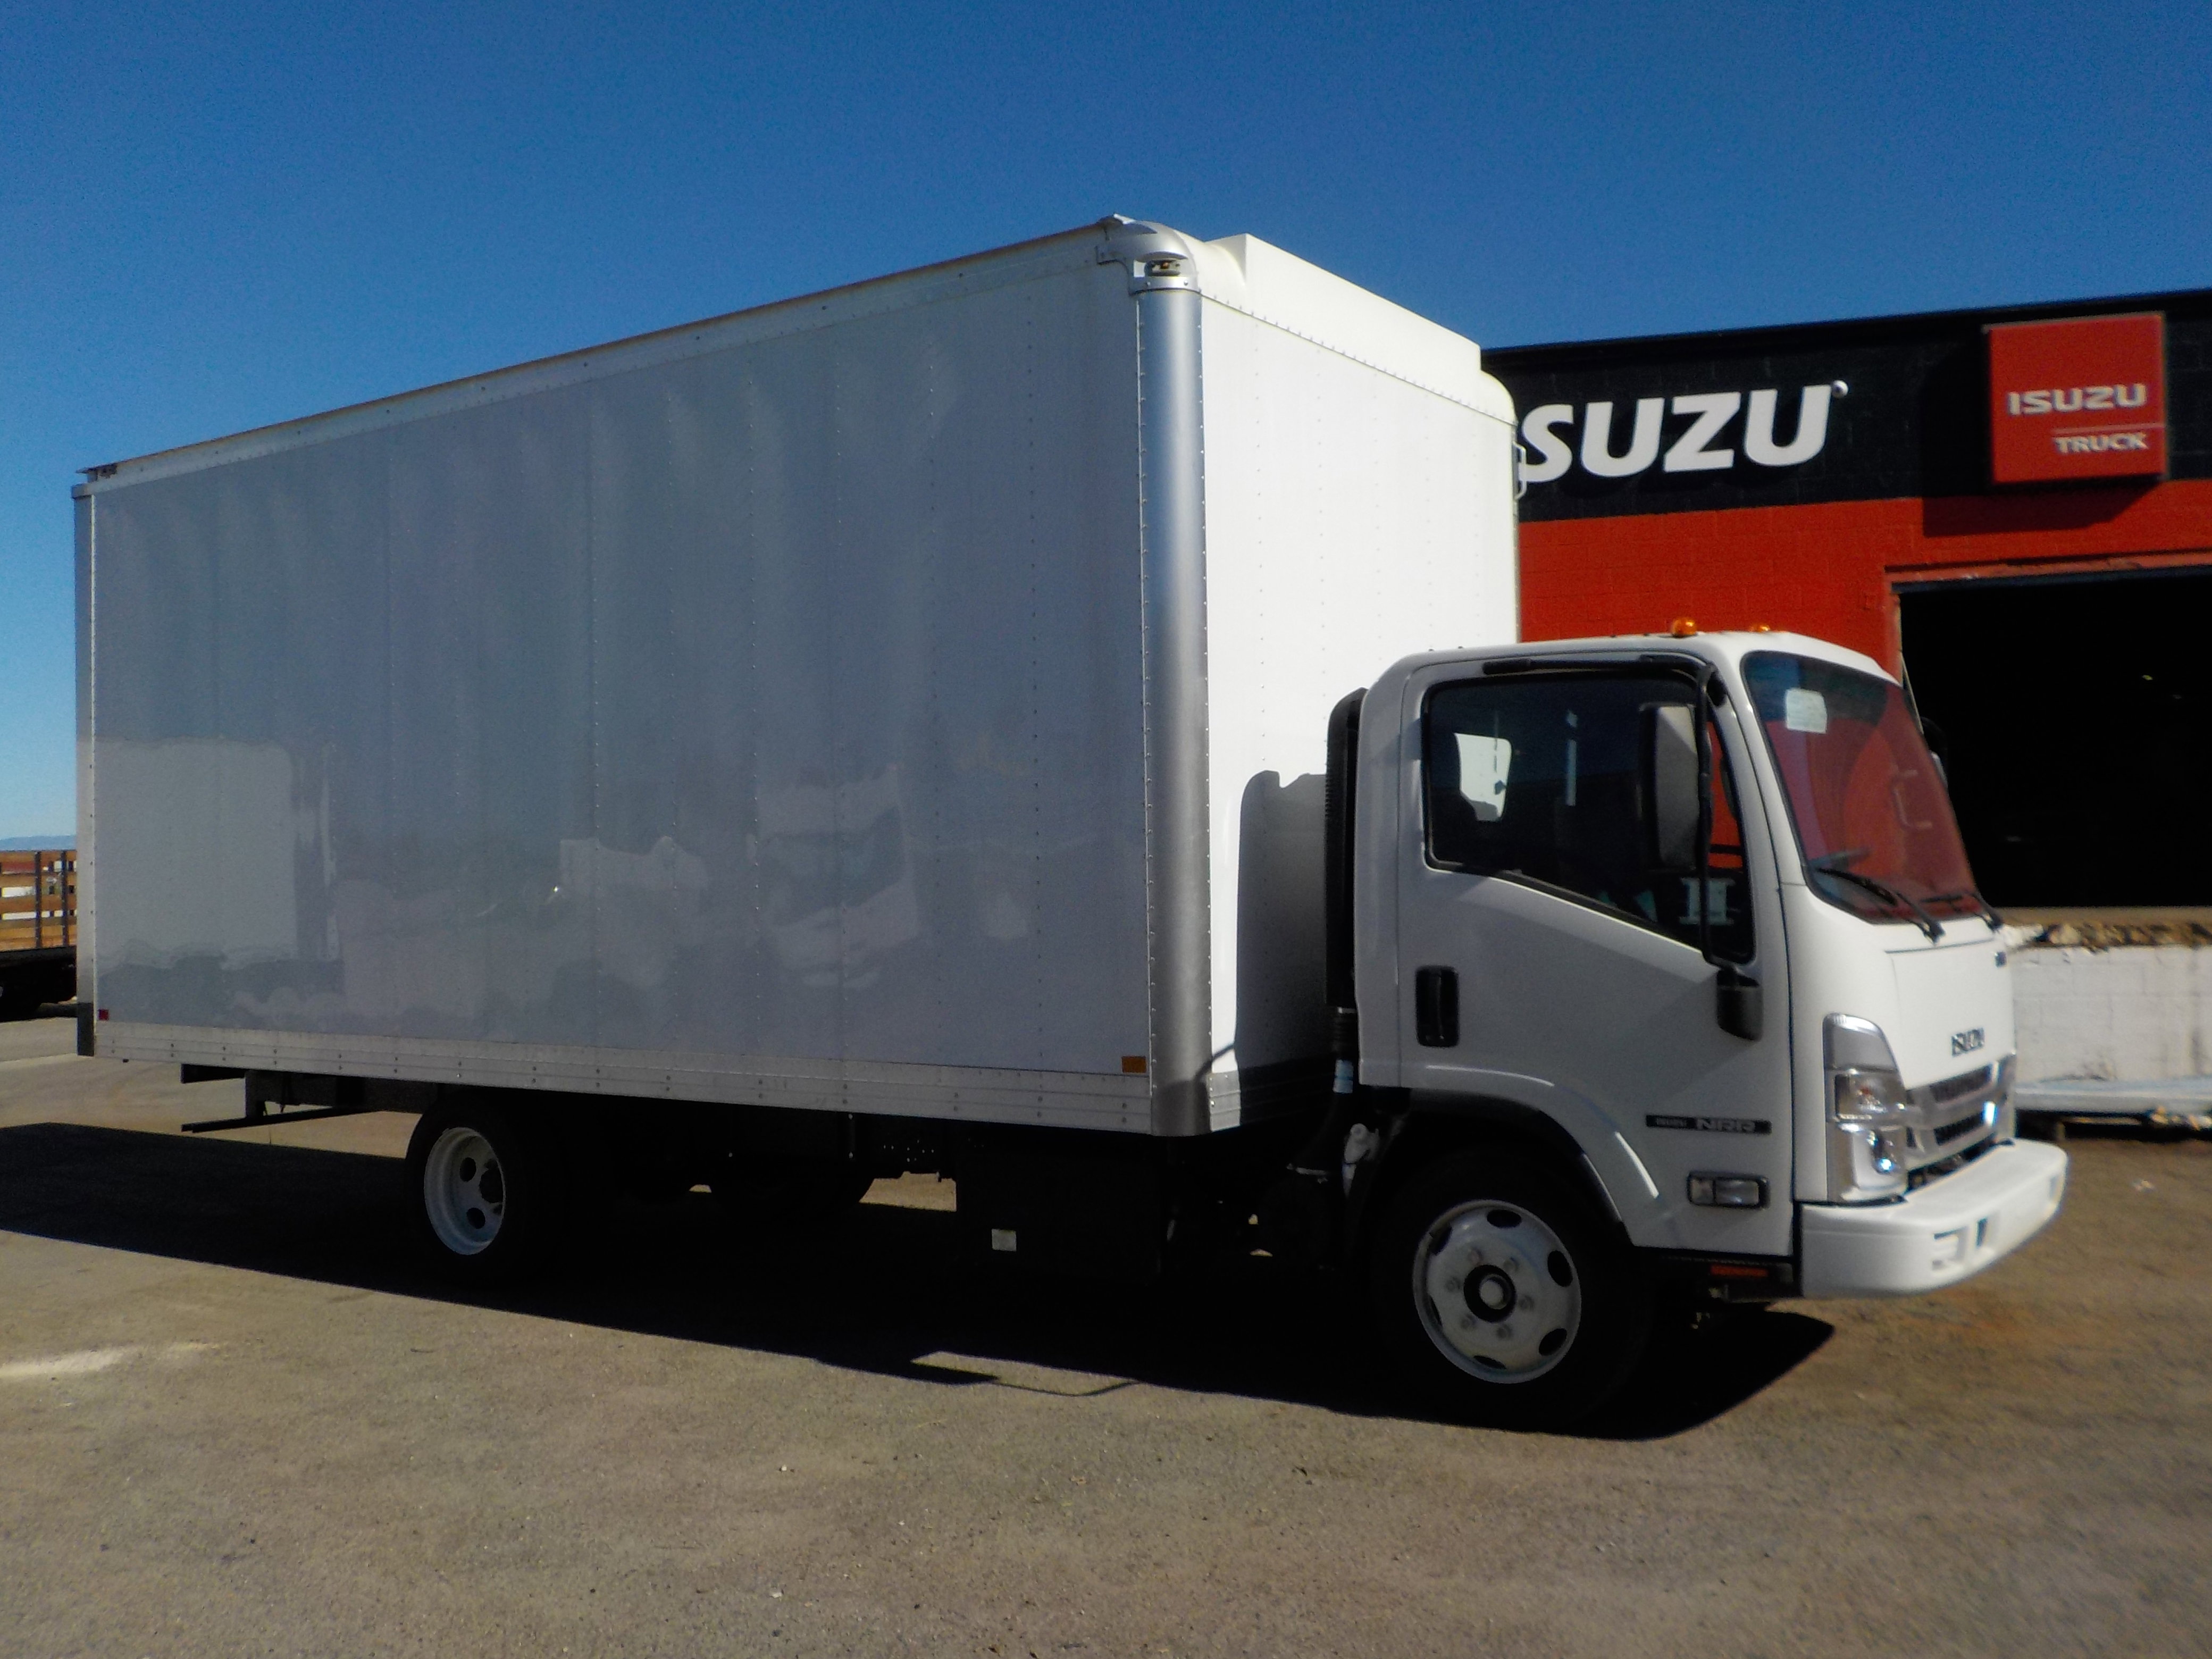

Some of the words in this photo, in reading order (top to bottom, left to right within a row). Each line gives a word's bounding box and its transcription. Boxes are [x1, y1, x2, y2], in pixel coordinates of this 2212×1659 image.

[2007, 383, 2147, 415] ISUZU
[1519, 385, 1832, 483] SUZU
[2055, 432, 2148, 454] TRUCK
